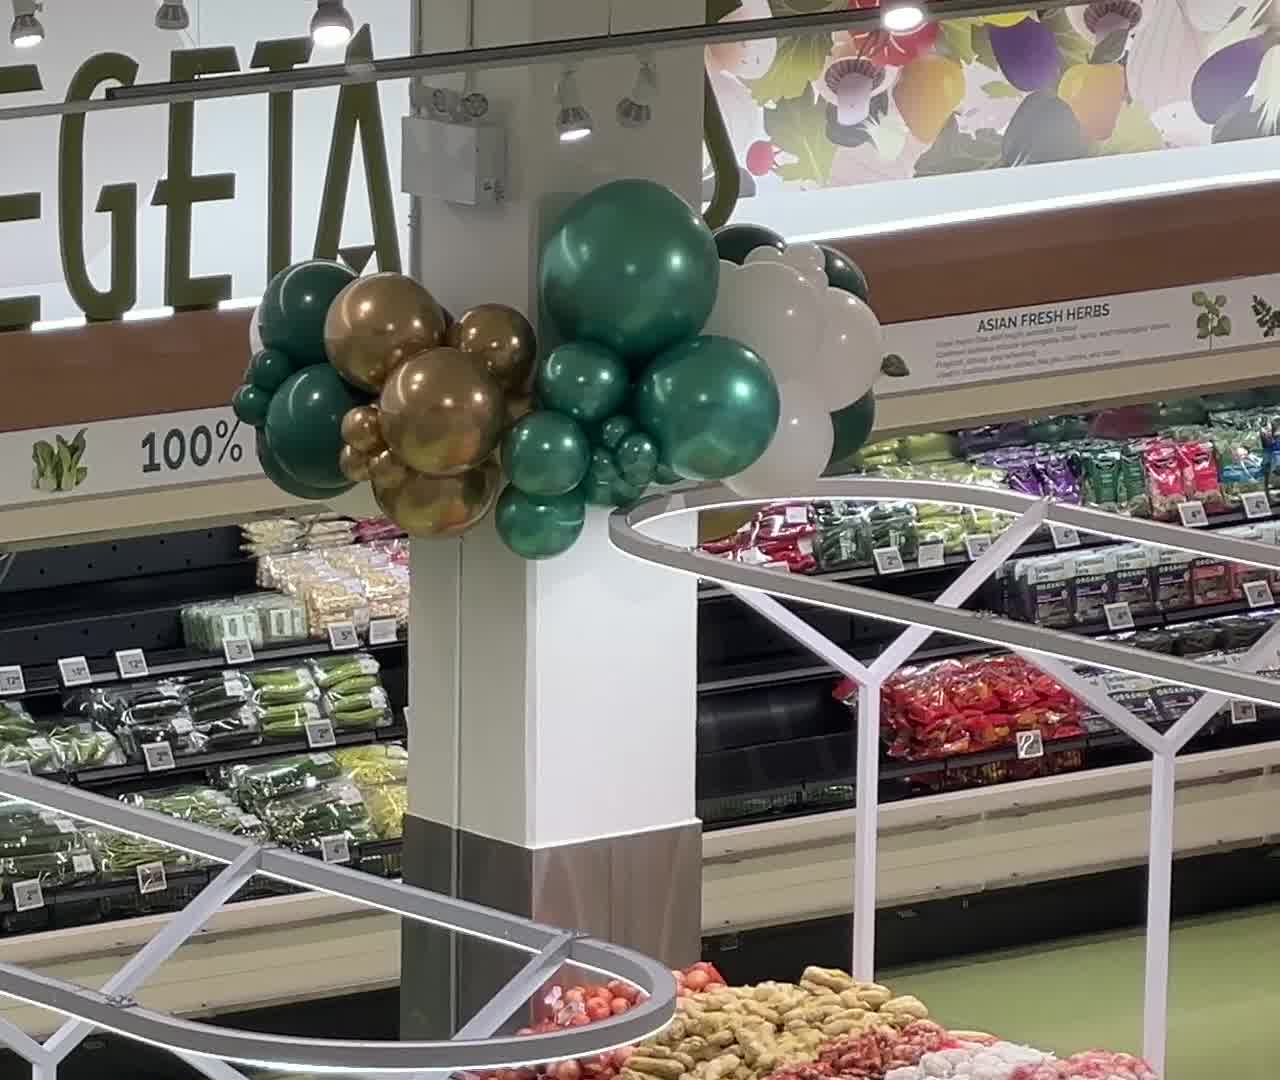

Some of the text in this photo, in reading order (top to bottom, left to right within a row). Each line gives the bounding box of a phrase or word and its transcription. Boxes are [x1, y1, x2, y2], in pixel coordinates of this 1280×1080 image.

[977, 303, 1110, 332] ASIAN FRESH HERBS
[140, 421, 243, 473] 100%
